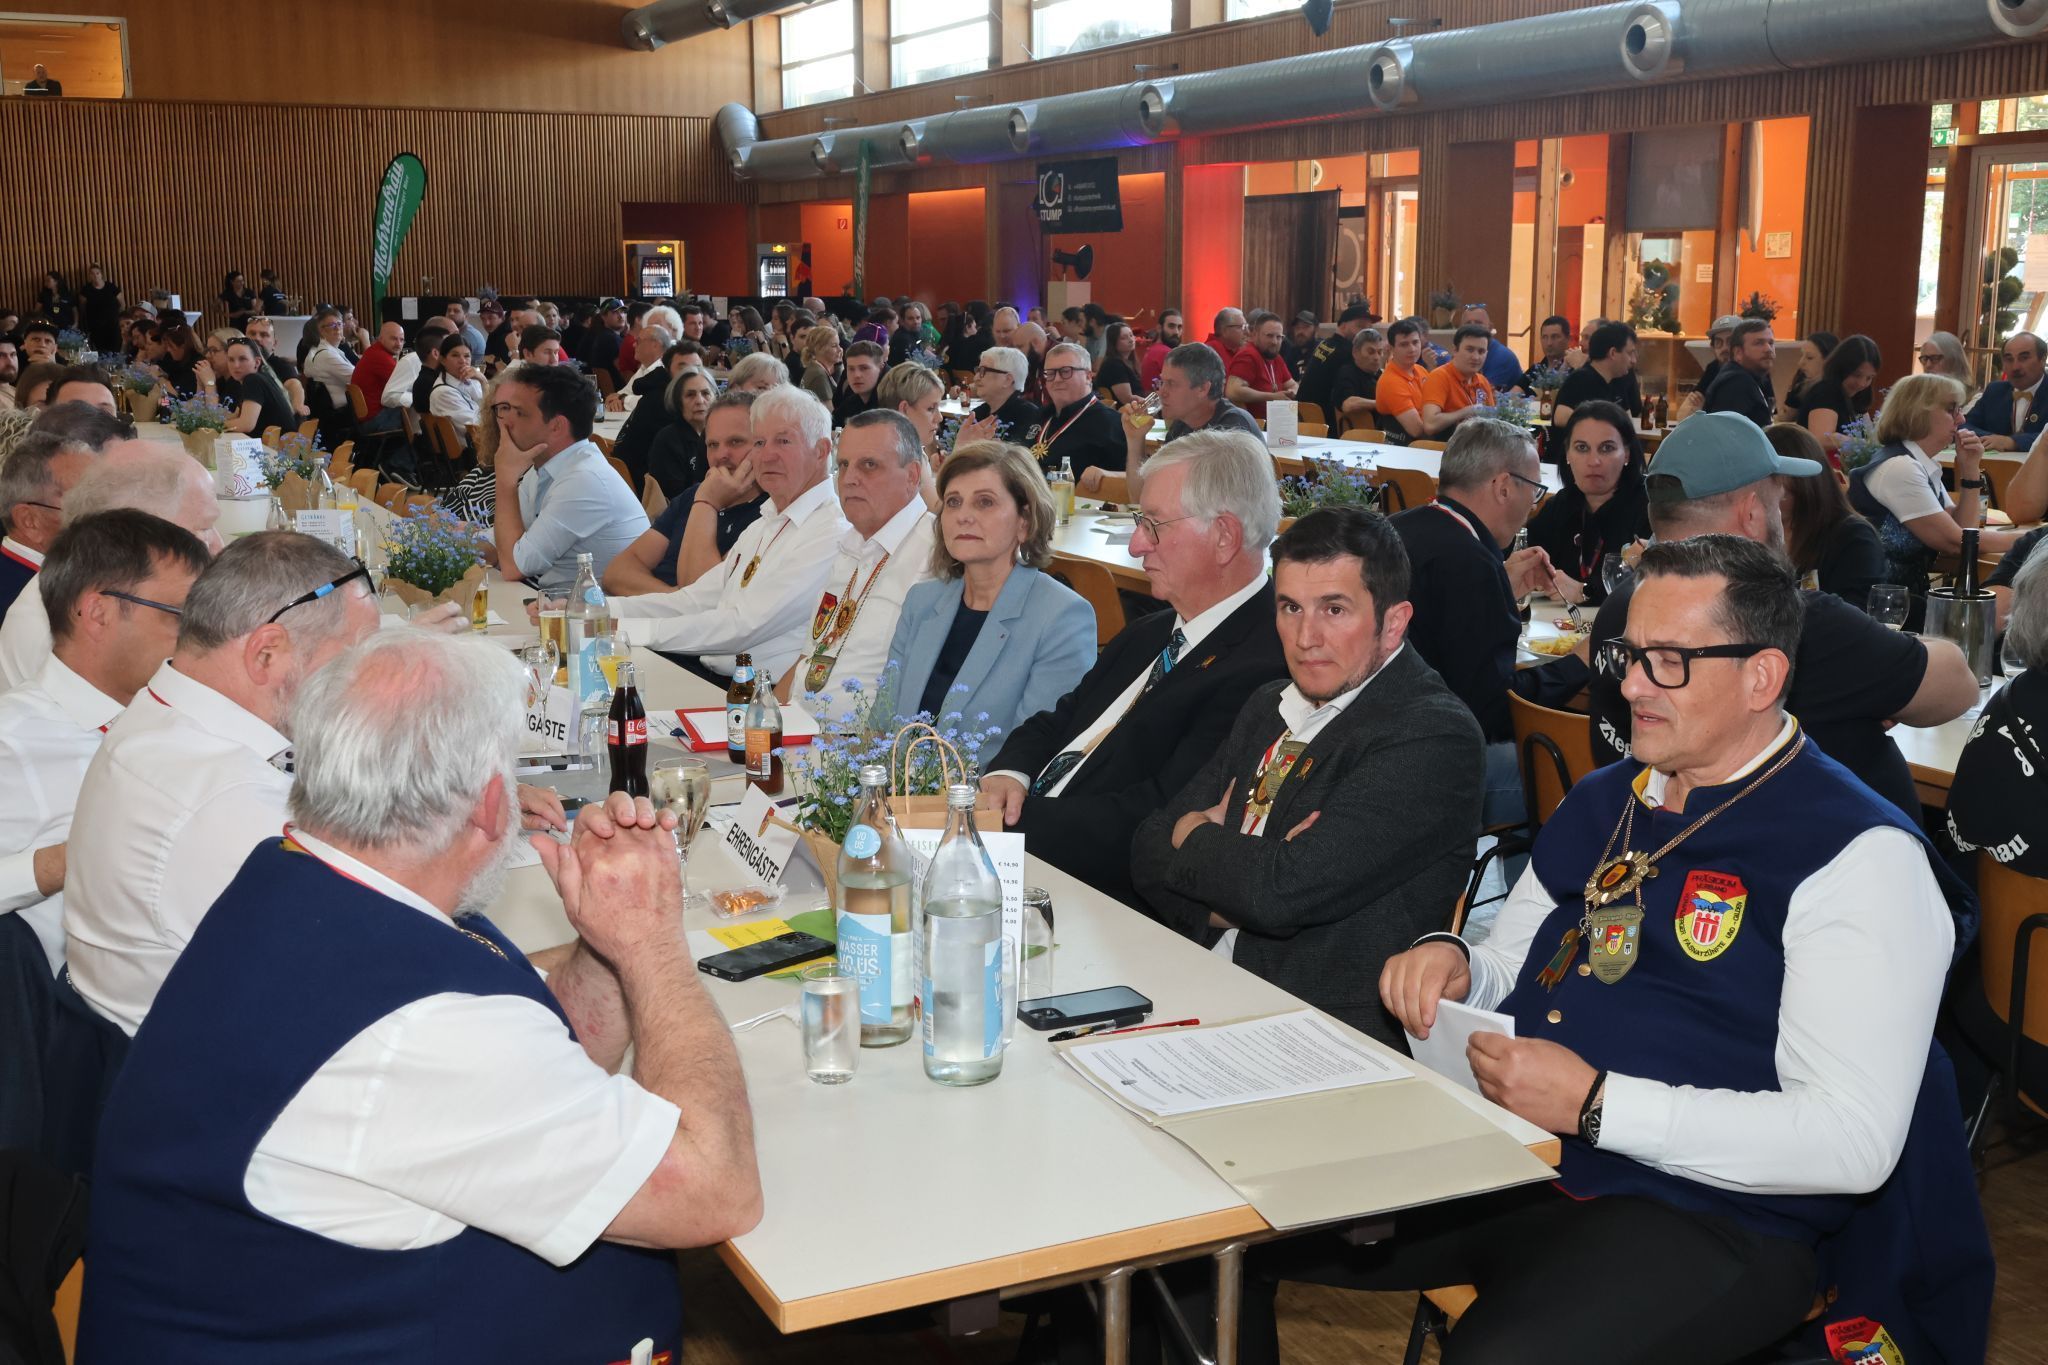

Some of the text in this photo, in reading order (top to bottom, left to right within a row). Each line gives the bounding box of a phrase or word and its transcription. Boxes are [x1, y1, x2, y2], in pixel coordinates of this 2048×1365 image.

[374, 161, 404, 284] Mohrenbräu
[726, 822, 780, 883] EHRENGÄSTE
[838, 939, 878, 957] WASSER
